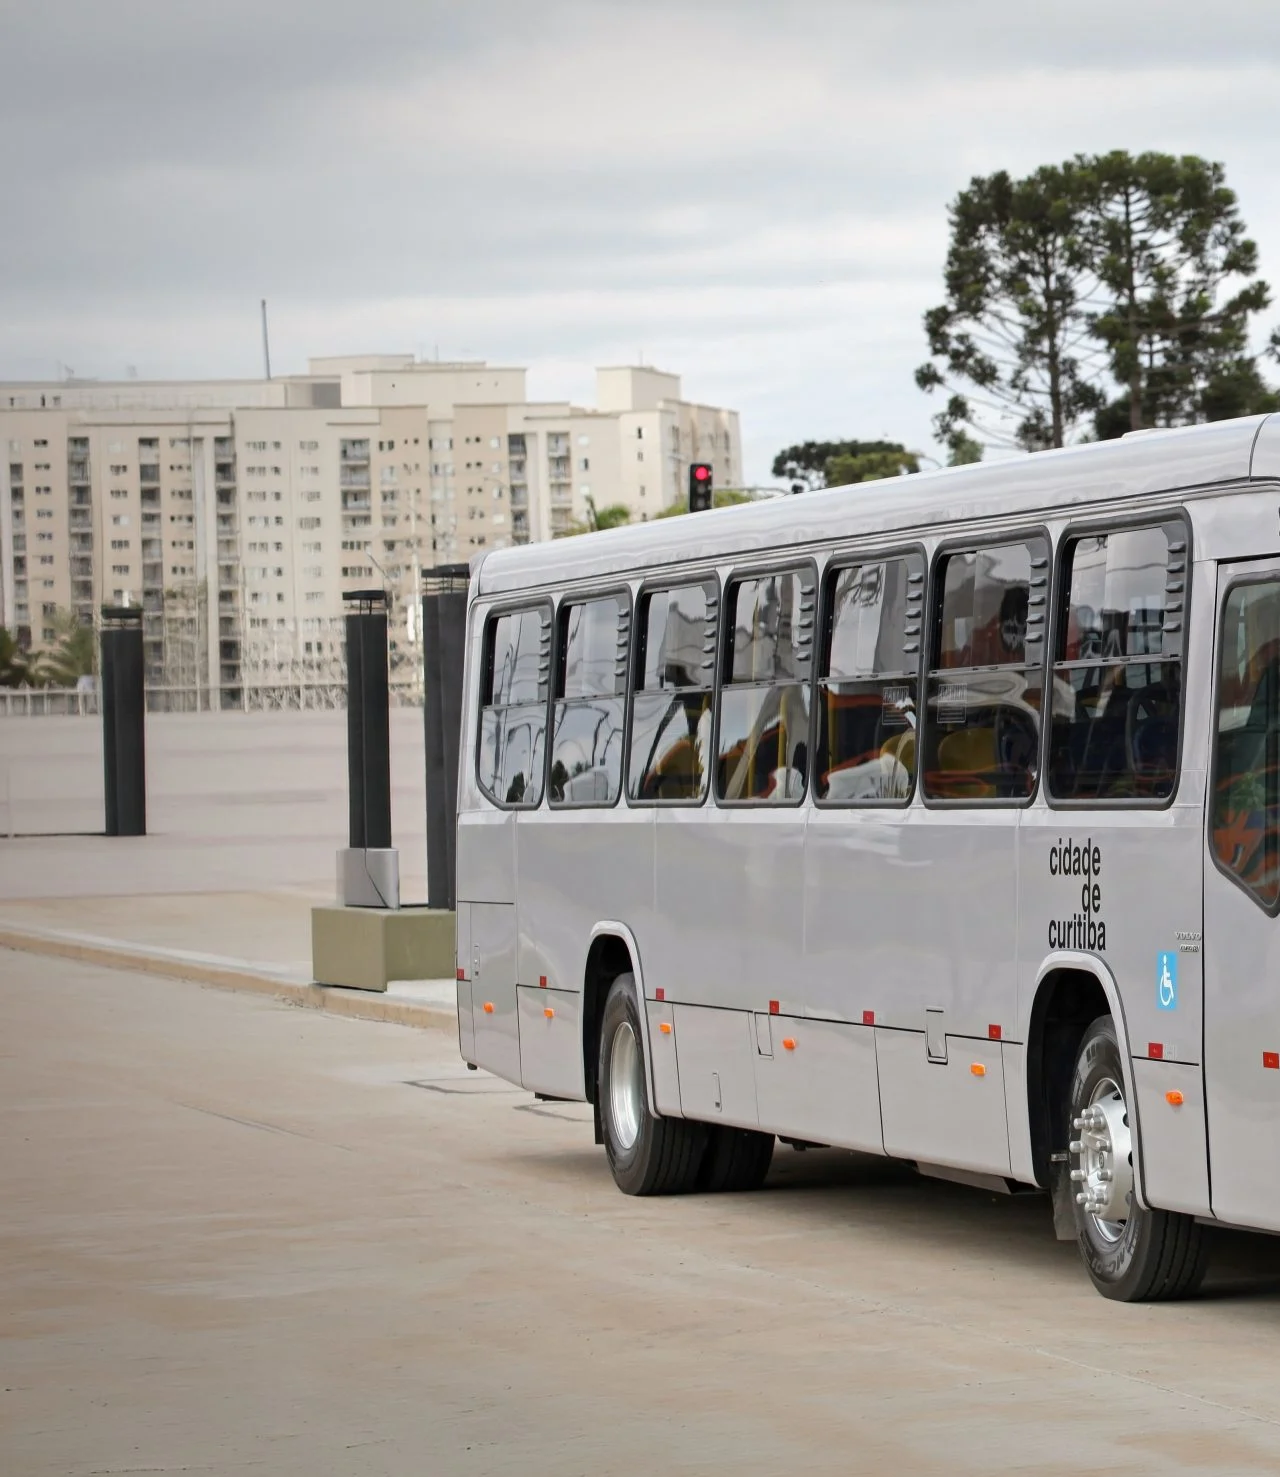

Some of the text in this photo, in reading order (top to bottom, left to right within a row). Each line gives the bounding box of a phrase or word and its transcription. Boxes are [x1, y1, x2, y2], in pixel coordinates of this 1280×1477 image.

[1049, 838, 1101, 876] cidade
[1081, 877, 1101, 914] de
[1048, 913, 1106, 951] curitiba
